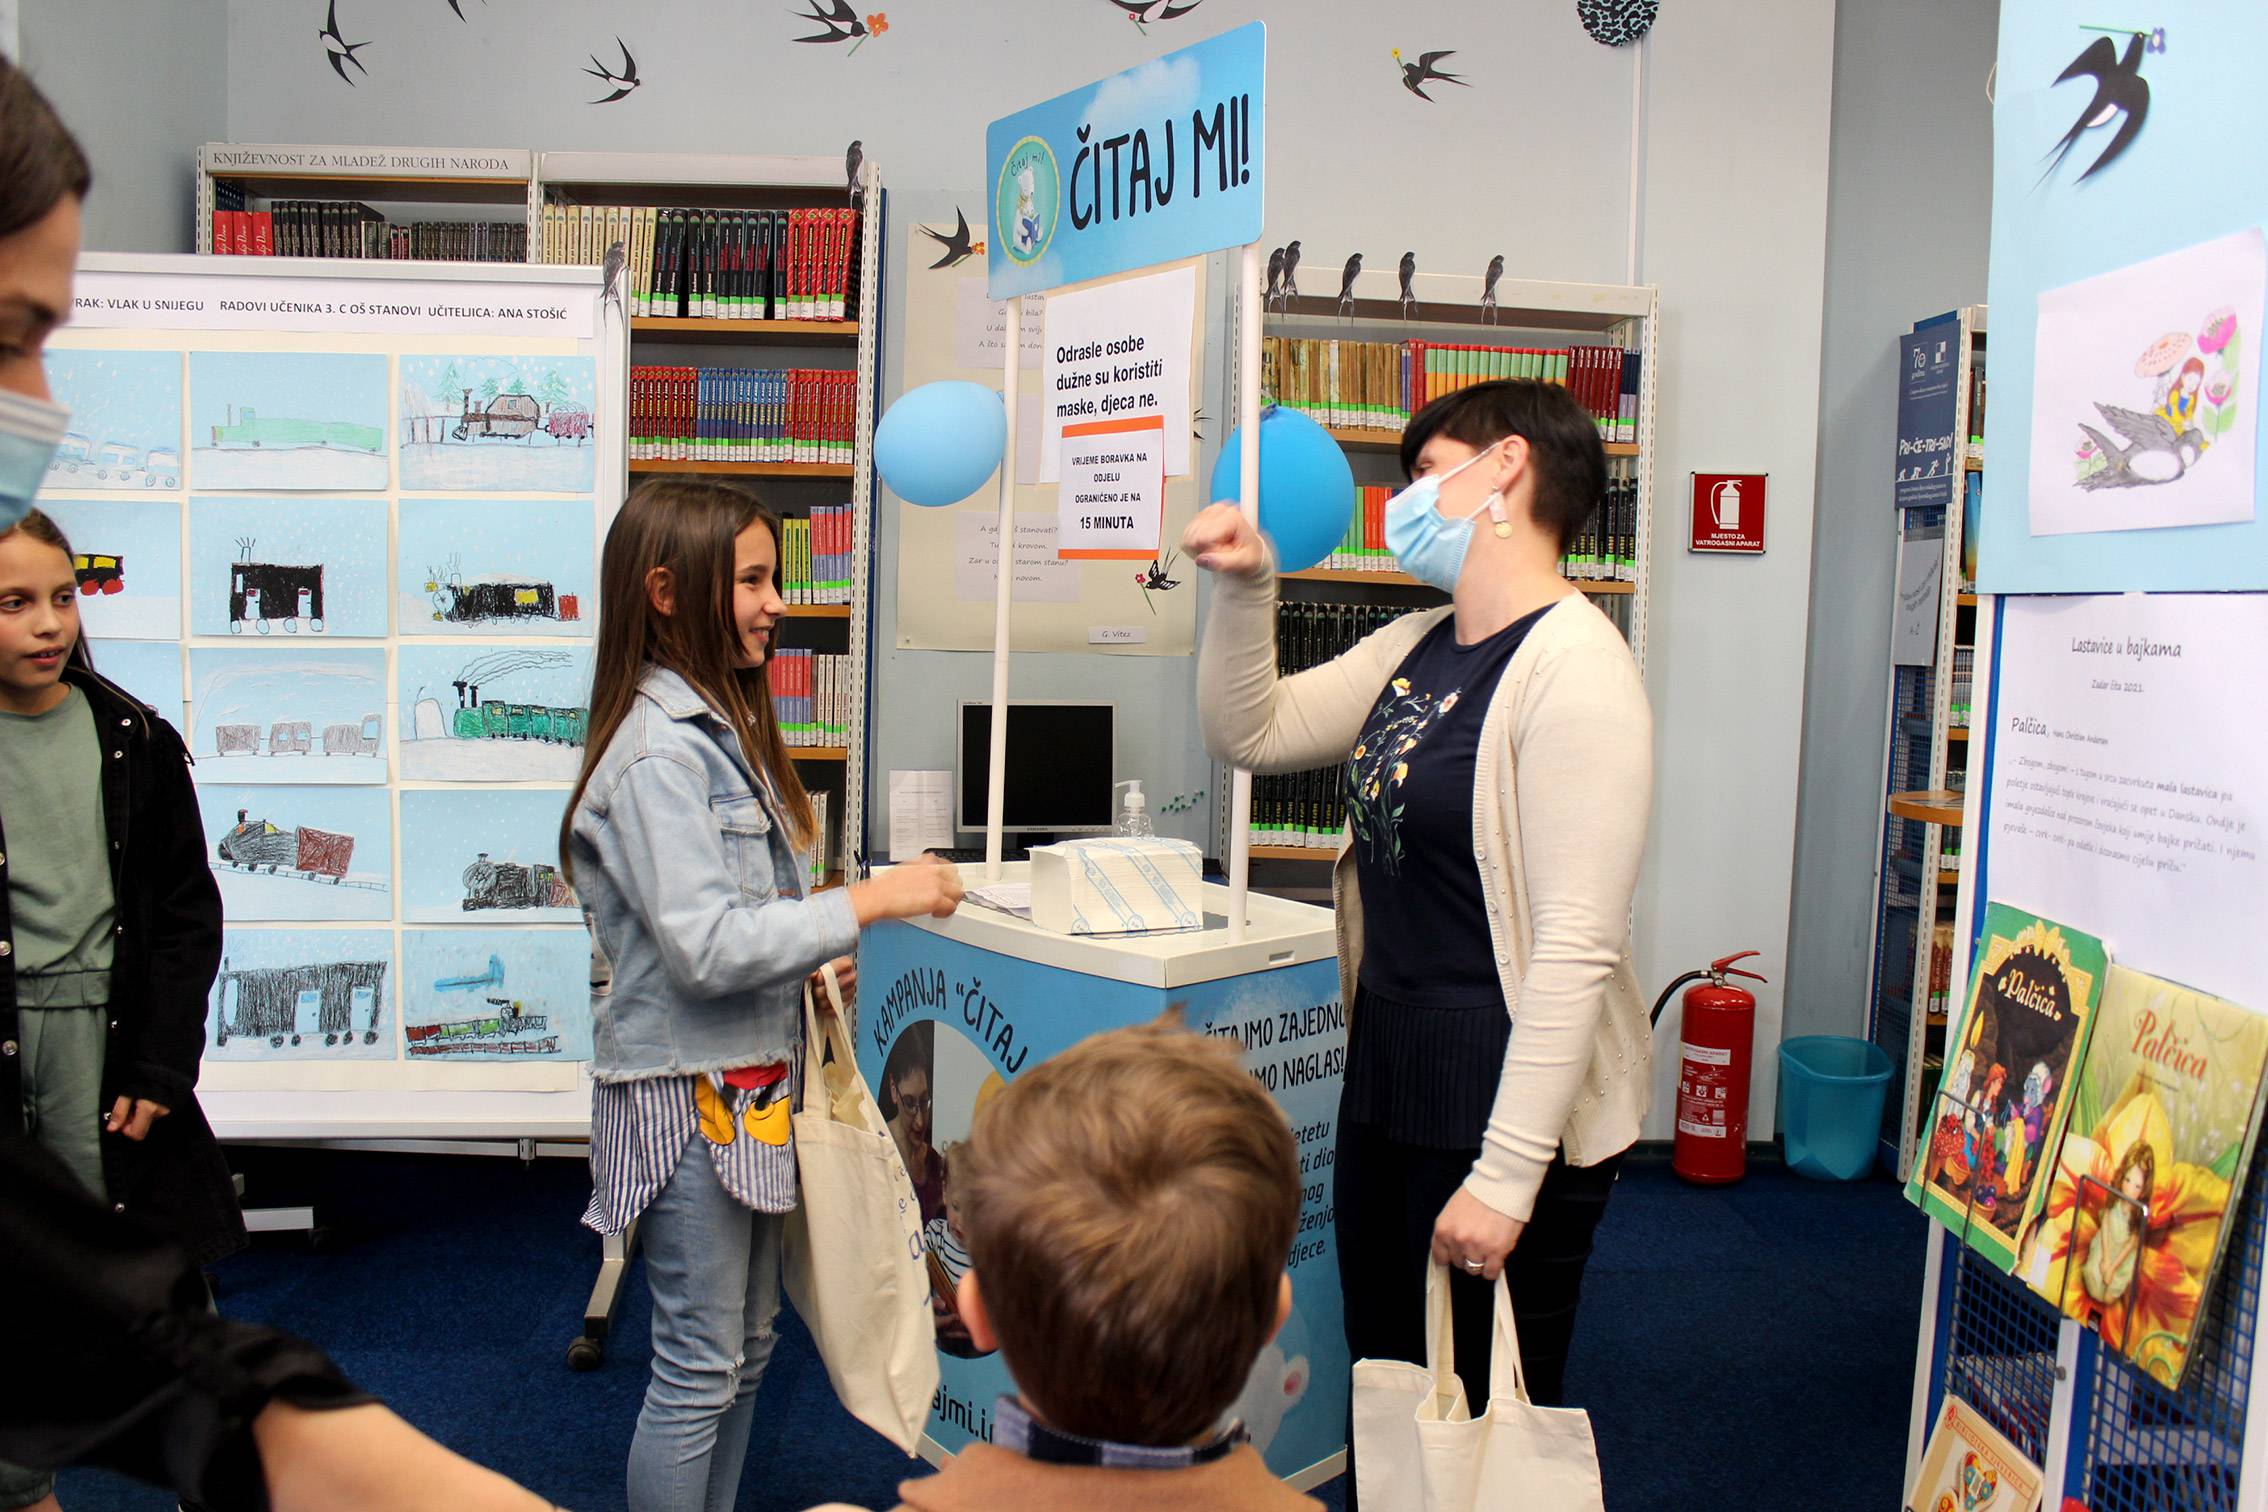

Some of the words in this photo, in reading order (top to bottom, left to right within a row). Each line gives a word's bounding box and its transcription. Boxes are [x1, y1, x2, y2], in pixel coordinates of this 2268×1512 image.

[213, 151, 305, 166] KNJIŽEVNOST
[309, 153, 328, 166] ZA
[331, 153, 387, 168] MLADEŽ
[391, 156, 446, 168] DRUGIH
[450, 157, 510, 170] NARODA
[1070, 119, 1174, 231] ČITAJ
[1193, 93, 1250, 198] MI!
[74, 298, 104, 309] RAK:
[107, 298, 139, 310] VLAK
[142, 299, 151, 310] U
[154, 300, 204, 311] SNIJEGU
[220, 300, 267, 312] RADOVI
[270, 299, 322, 313] UČENIKA
[325, 304, 335, 314] 3.
[339, 304, 347, 314] C
[350, 302, 366, 315] OŠ
[369, 304, 421, 316] STANOVI
[428, 303, 494, 318] UČITELJICA:
[497, 307, 524, 318] ANA
[526, 306, 568, 320] STOŠIĆ
[1056, 341, 1102, 364] Odrasle
[1106, 334, 1145, 356] osobe
[1056, 371, 1092, 391] dužne
[1095, 370, 1109, 385] su
[1113, 358, 1163, 383] koristiti
[1056, 398, 1098, 418] maske,
[1101, 394, 1135, 415] djeca
[1138, 392, 1158, 408] ne.
[1071, 456, 1099, 466] VRIJEME
[1100, 454, 1134, 464] BORAVKA
[1136, 452, 1147, 462] NA
[1093, 472, 1121, 482] ODJELU
[1075, 492, 1118, 503] OGRANIČENO
[1120, 493, 1129, 502] JE
[1130, 492, 1141, 502] NA
[1080, 516, 1091, 529] 15
[1093, 516, 1134, 529] MINUTA
[2072, 636, 2113, 654] Lastavice
[2116, 643, 2122, 654] u
[2126, 636, 2182, 662] bajkama
[2004, 968, 2056, 1019] Palčica
[873, 966, 947, 1058] KAMPANJA
[2131, 1008, 2208, 1080] Palčica
[1283, 1046, 1345, 1090] NAGLAS!
[1287, 1239, 1327, 1269] djece.
